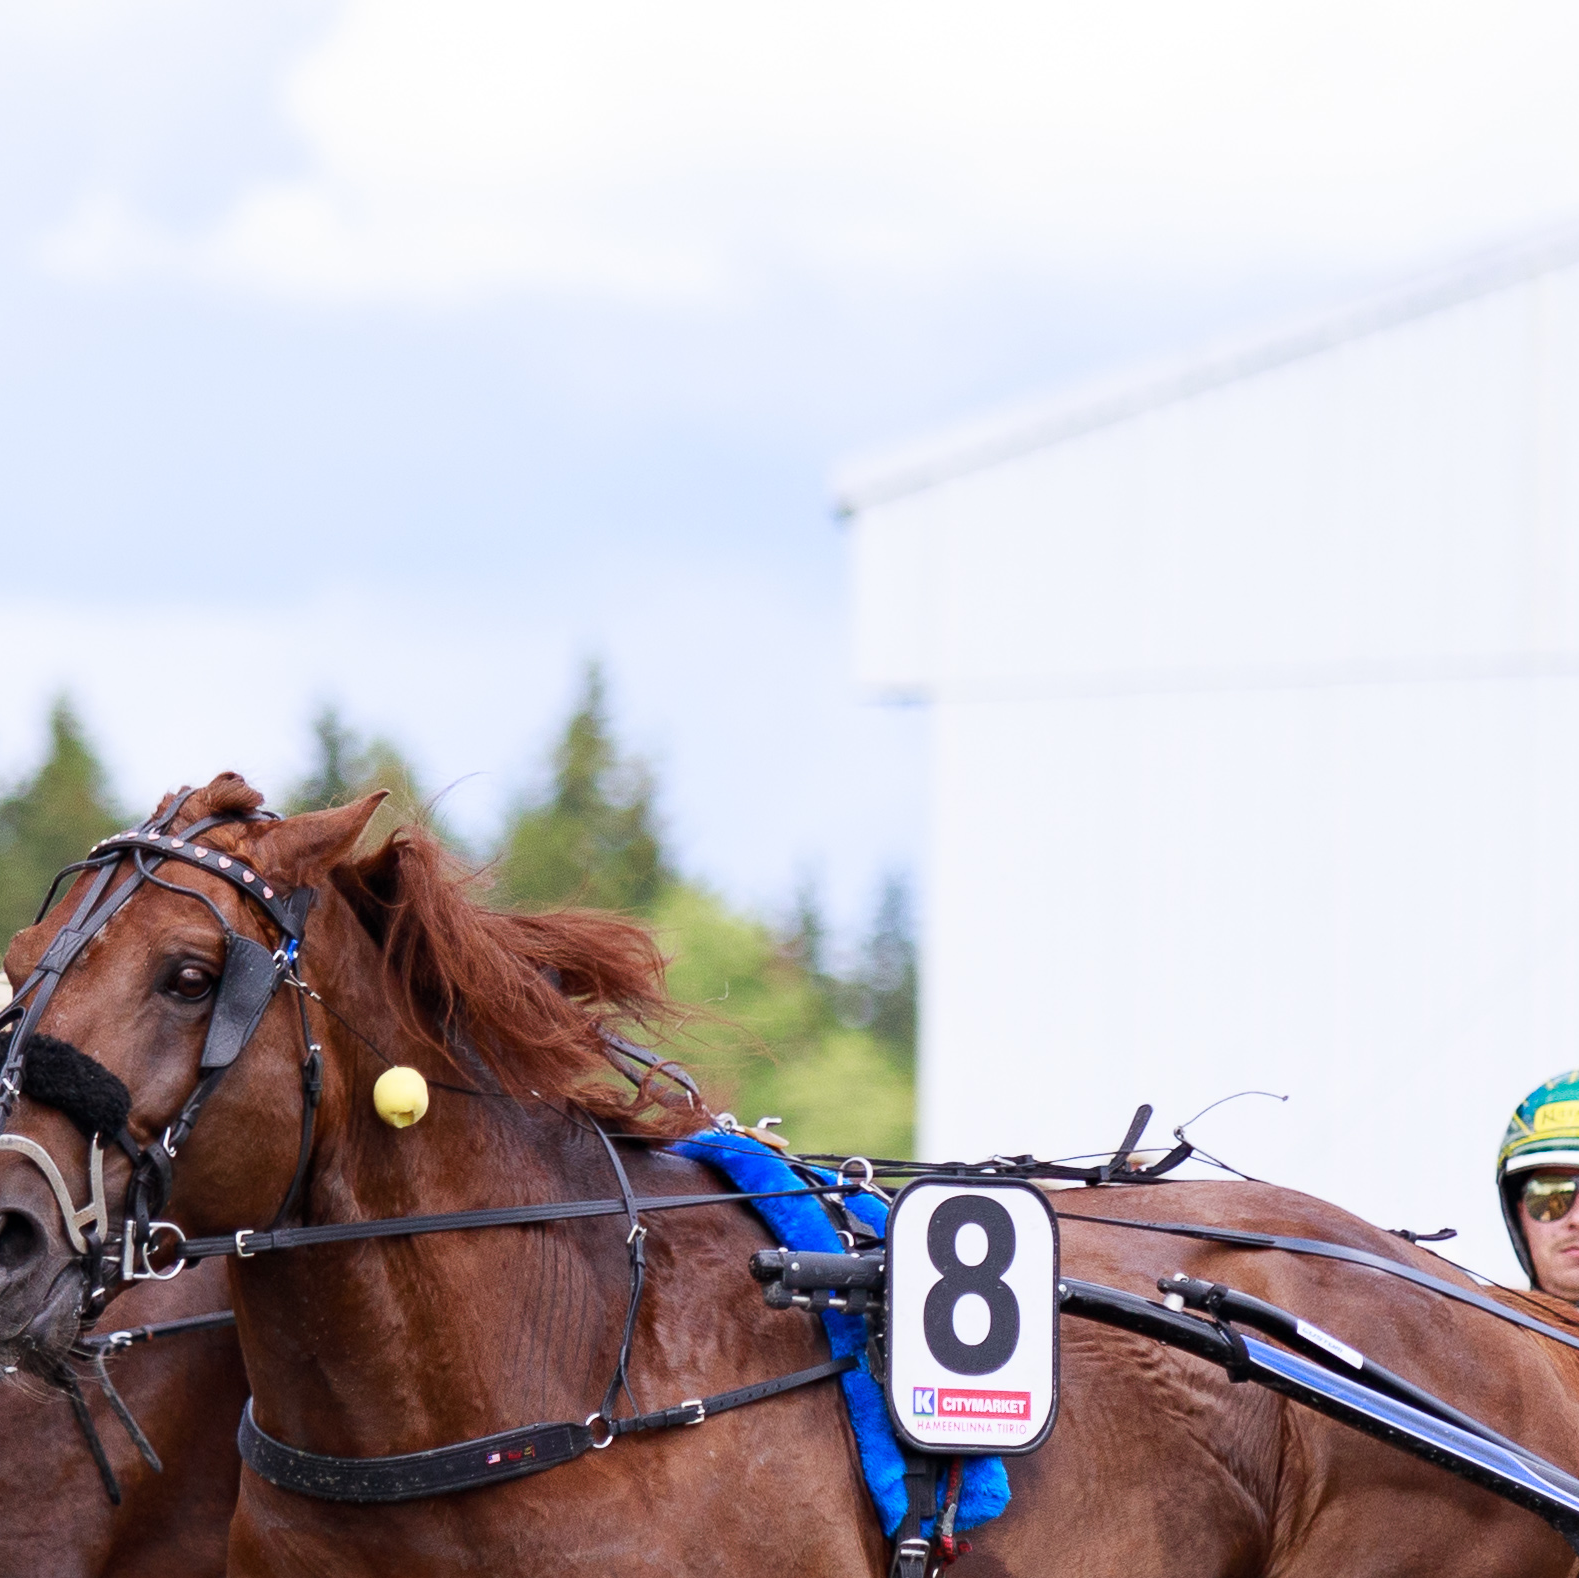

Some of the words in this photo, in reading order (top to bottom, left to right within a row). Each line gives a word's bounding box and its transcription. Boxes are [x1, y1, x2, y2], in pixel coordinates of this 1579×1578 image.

[923, 1194, 1021, 1376] 8
[914, 1390, 934, 1413] K
[942, 1397, 1027, 1414] CITYMARKET
